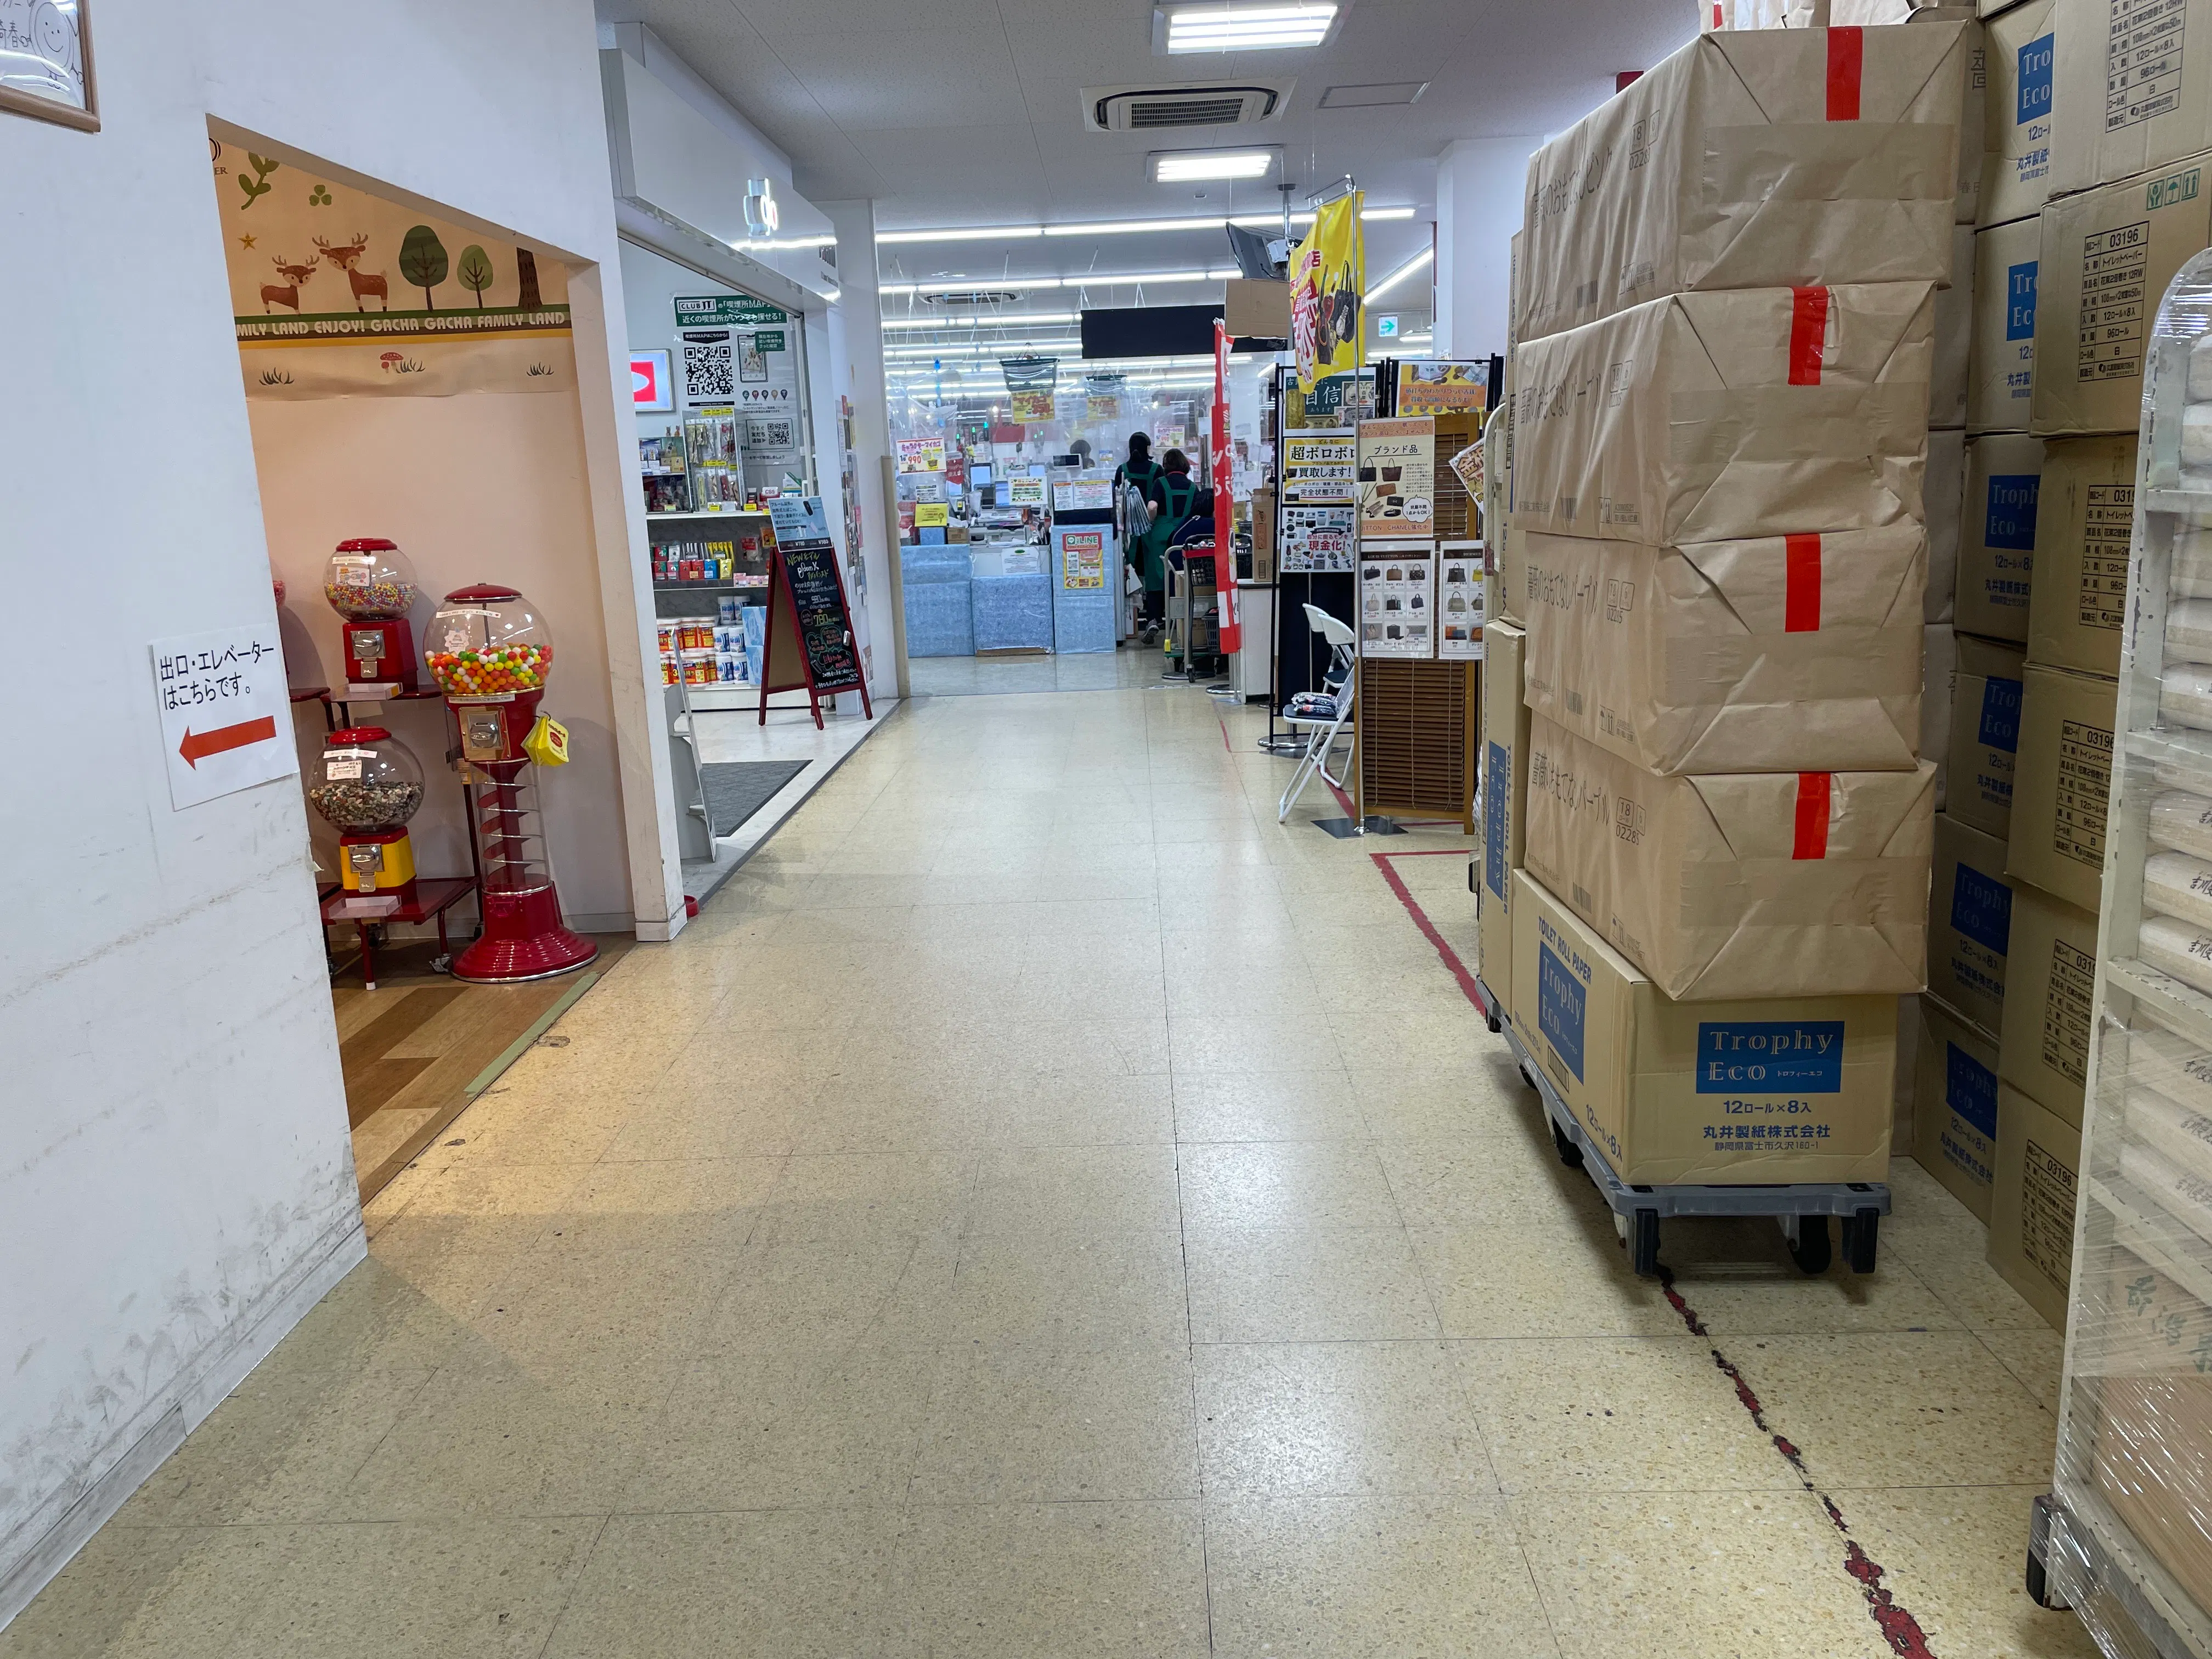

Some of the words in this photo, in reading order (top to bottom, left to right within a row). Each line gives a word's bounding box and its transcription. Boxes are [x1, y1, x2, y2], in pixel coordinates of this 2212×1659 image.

[2022, 84, 2050, 110] Eco
[1633, 126, 1641, 142] 18
[2109, 228, 2139, 248] 03196
[272, 321, 309, 335] LAND
[313, 320, 365, 334] ENJOY!
[370, 318, 420, 331] GACHA
[424, 316, 472, 330] GACHA
[477, 313, 523, 328] FAMILY
[528, 312, 565, 325] LAND
[2107, 327, 2129, 339] 96ロール
[1374, 444, 1418, 455] ブランド品
[1990, 516, 2016, 536] Eco
[1080, 535, 1098, 543] LINE
[2118, 599, 2124, 609] 白
[160, 640, 274, 682] 出口・エレベーター
[163, 672, 251, 710] はこちらです。
[1984, 714, 2012, 738] Eco
[1620, 802, 1631, 816] 18
[1959, 872, 2010, 919] Trophy
[1538, 916, 1556, 946] TOILET
[1558, 937, 1571, 963] ROLL
[1573, 951, 1591, 985] PAPER
[1543, 954, 1582, 1025] Trophy
[1542, 993, 1560, 1035] Eco
[1710, 1029, 1833, 1055] Trophy
[1708, 1061, 1766, 1081] Eco
[1723, 1099, 1812, 1115] 12ロール×8入
[1586, 1103, 1623, 1163] 12ロール×8入
[1703, 1124, 1831, 1139] 丸井製紙株式会社
[1714, 1141, 1819, 1152] 静岡県富士市久沢160-1
